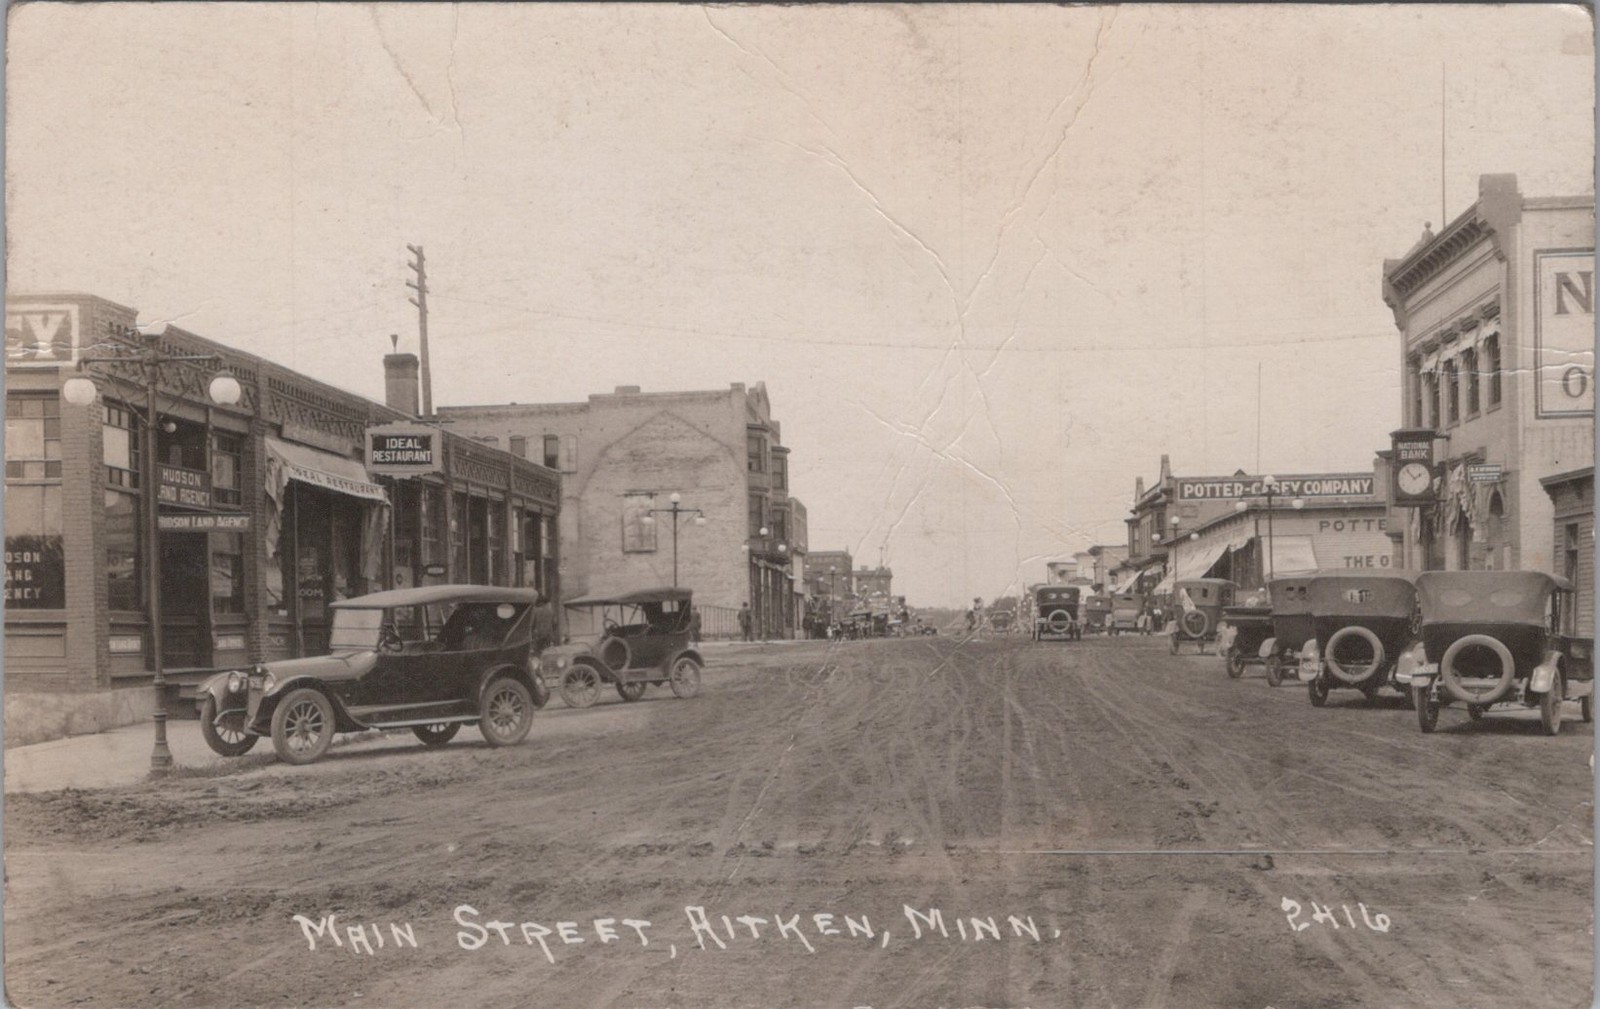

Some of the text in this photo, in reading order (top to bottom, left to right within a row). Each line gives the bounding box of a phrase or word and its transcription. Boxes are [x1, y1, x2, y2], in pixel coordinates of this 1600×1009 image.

[386, 438, 421, 449] IDEAL
[1399, 442, 1430, 450] NATIONAL
[373, 450, 431, 462] RESTAURANT
[1401, 450, 1427, 459] BANK
[162, 468, 201, 487] HUDSON
[325, 476, 381, 495] RESTAURANT
[1303, 479, 1371, 495] COMPANY
[157, 484, 210, 507] AND AGENCY
[192, 516, 214, 527] LAND
[217, 516, 250, 527] AGENCY
[1343, 555, 1374, 568] THE
